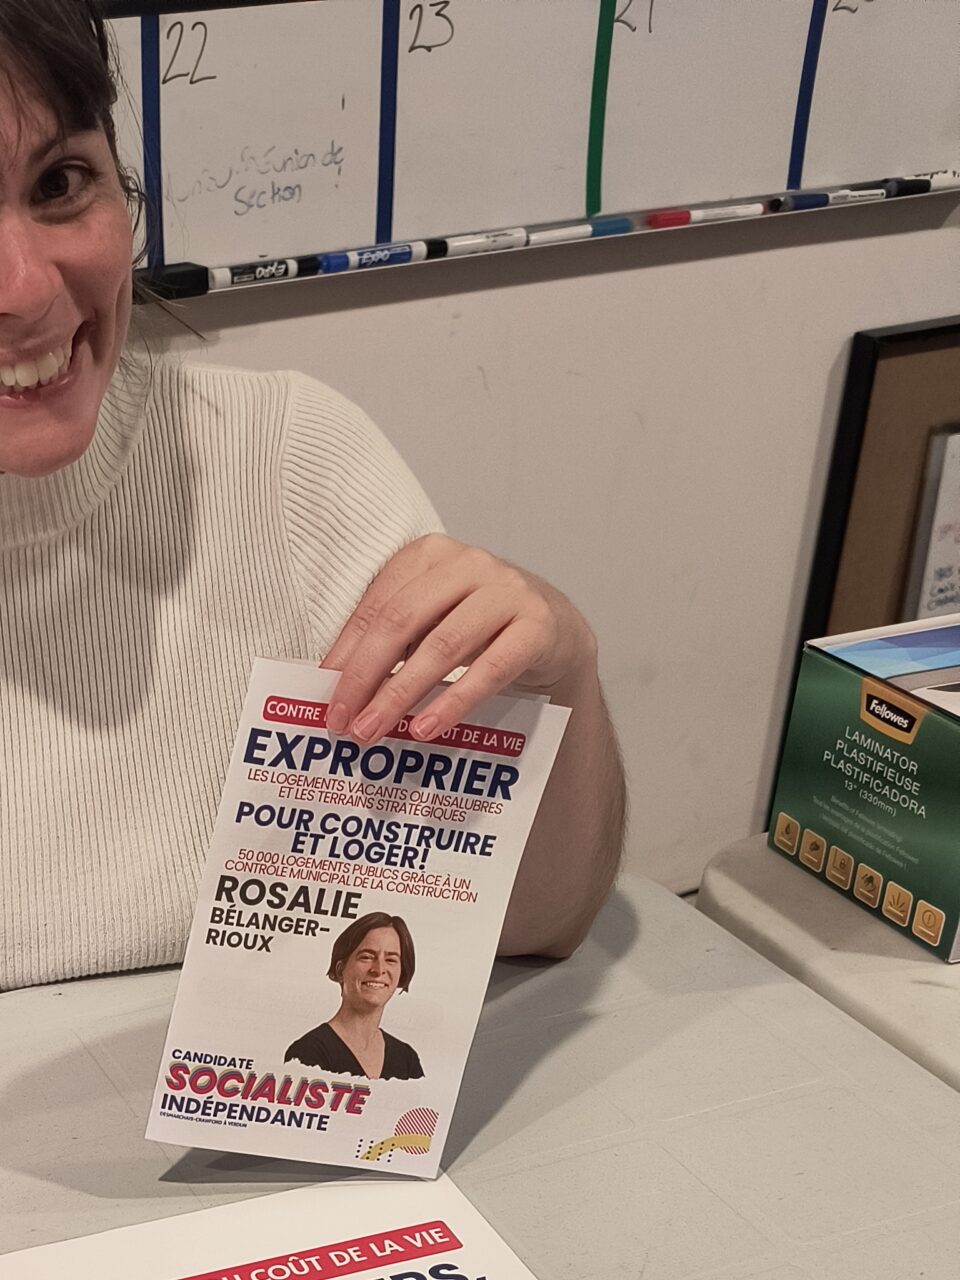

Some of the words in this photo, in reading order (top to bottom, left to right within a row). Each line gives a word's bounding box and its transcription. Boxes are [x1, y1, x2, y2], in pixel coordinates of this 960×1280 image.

[408, 0, 454, 53] 23
[163, 21, 216, 85] 22
[267, 701, 321, 720] CONTRE
[462, 730, 480, 743] DE
[483, 733, 497, 746] LA
[504, 736, 524, 750] VIE
[869, 700, 909, 728] Fellowes
[243, 728, 519, 800] EXPROPRIER
[835, 739, 921, 796] PLASTIFIEUSE
[845, 726, 918, 775] LAMINATOR
[248, 768, 269, 782] LES
[270, 772, 345, 792] LOGEMENTS
[348, 781, 408, 800] VACANTS
[410, 791, 430, 804] OU
[431, 794, 503, 814] INSALUBRES
[278, 786, 294, 798] ET
[294, 788, 315, 801] LES
[318, 790, 374, 809] TERRAINS
[376, 792, 466, 822] STRATÉGIQUES
[823, 750, 926, 819] PLASTIFICADORA
[859, 788, 896, 816] (330mm)
[236, 802, 314, 832] POUR
[320, 813, 496, 857] CONSTRUIRE
[291, 832, 325, 855] ET
[328, 836, 429, 870] LOGER!
[225, 860, 288, 877] CONTRÔLE
[289, 868, 350, 886] MUNICIPAL
[353, 876, 369, 888] DE
[370, 878, 383, 890] LA
[386, 881, 478, 902] CONSTRUCTION
[238, 849, 254, 860] 50
[256, 851, 279, 864] 000
[281, 854, 351, 873] LOGEMENTS
[352, 864, 399, 880] PUBLICS
[401, 871, 442, 886] GRÂCE
[442, 877, 450, 887] À
[454, 878, 471, 890] UN
[215, 875, 362, 919] ROSALIE
[205, 928, 274, 952] RIOUX
[210, 904, 330, 938] BÉLANGER-
[172, 1049, 254, 1069] CANDIDATE
[165, 1061, 371, 1115] SOCIALISTE
[161, 1093, 330, 1131] INDÉPENDANTE
[329, 1247, 367, 1266] DE
[369, 1240, 404, 1256] LA
[403, 1228, 449, 1247] VIE
